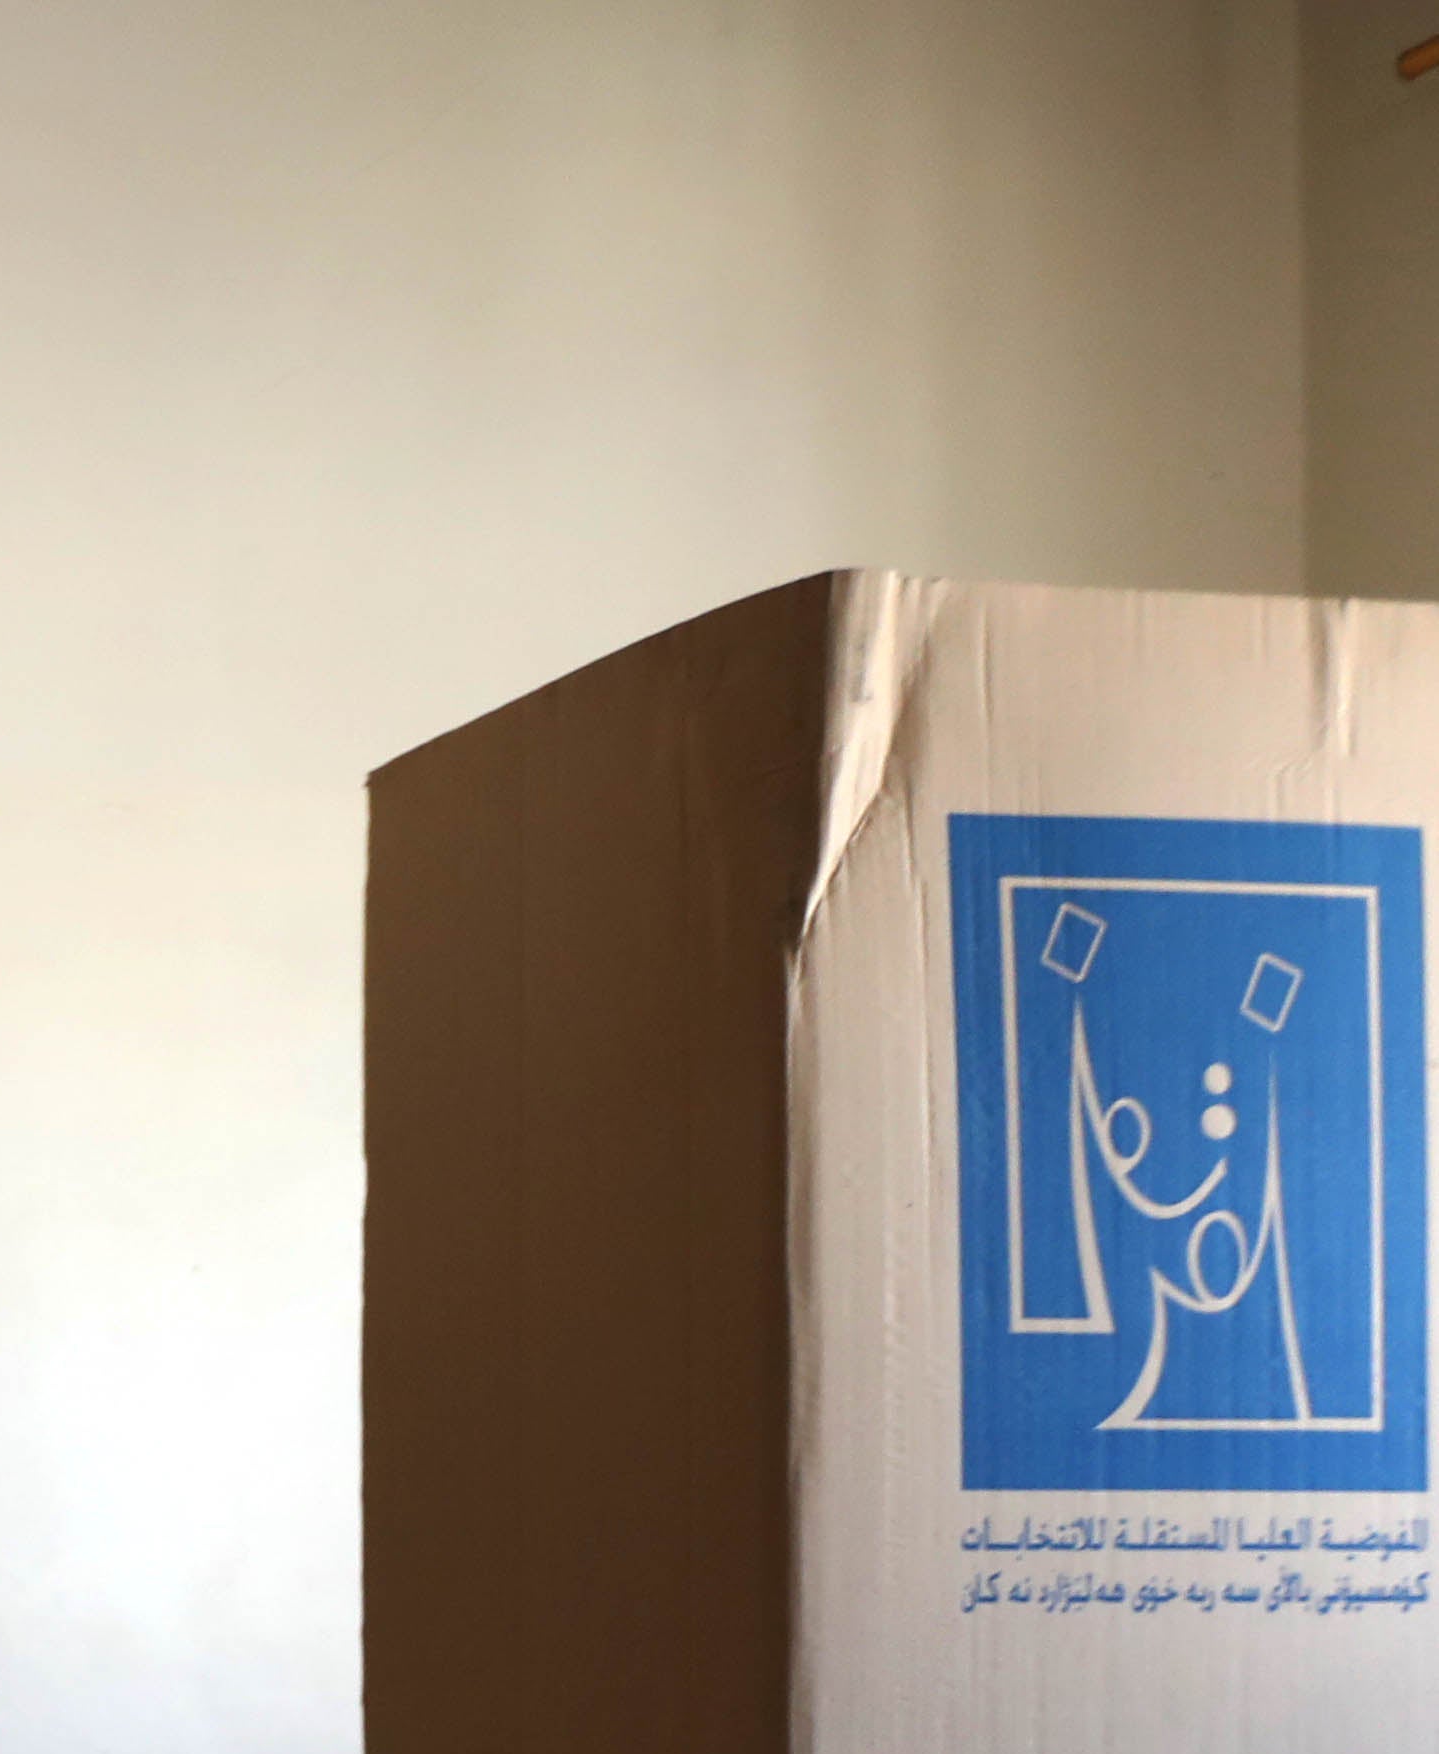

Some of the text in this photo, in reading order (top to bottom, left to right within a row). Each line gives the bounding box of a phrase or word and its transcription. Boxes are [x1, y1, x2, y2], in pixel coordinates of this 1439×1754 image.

[960, 1516, 1429, 1563] المفوضية العليا المستقلة للانتخابات
